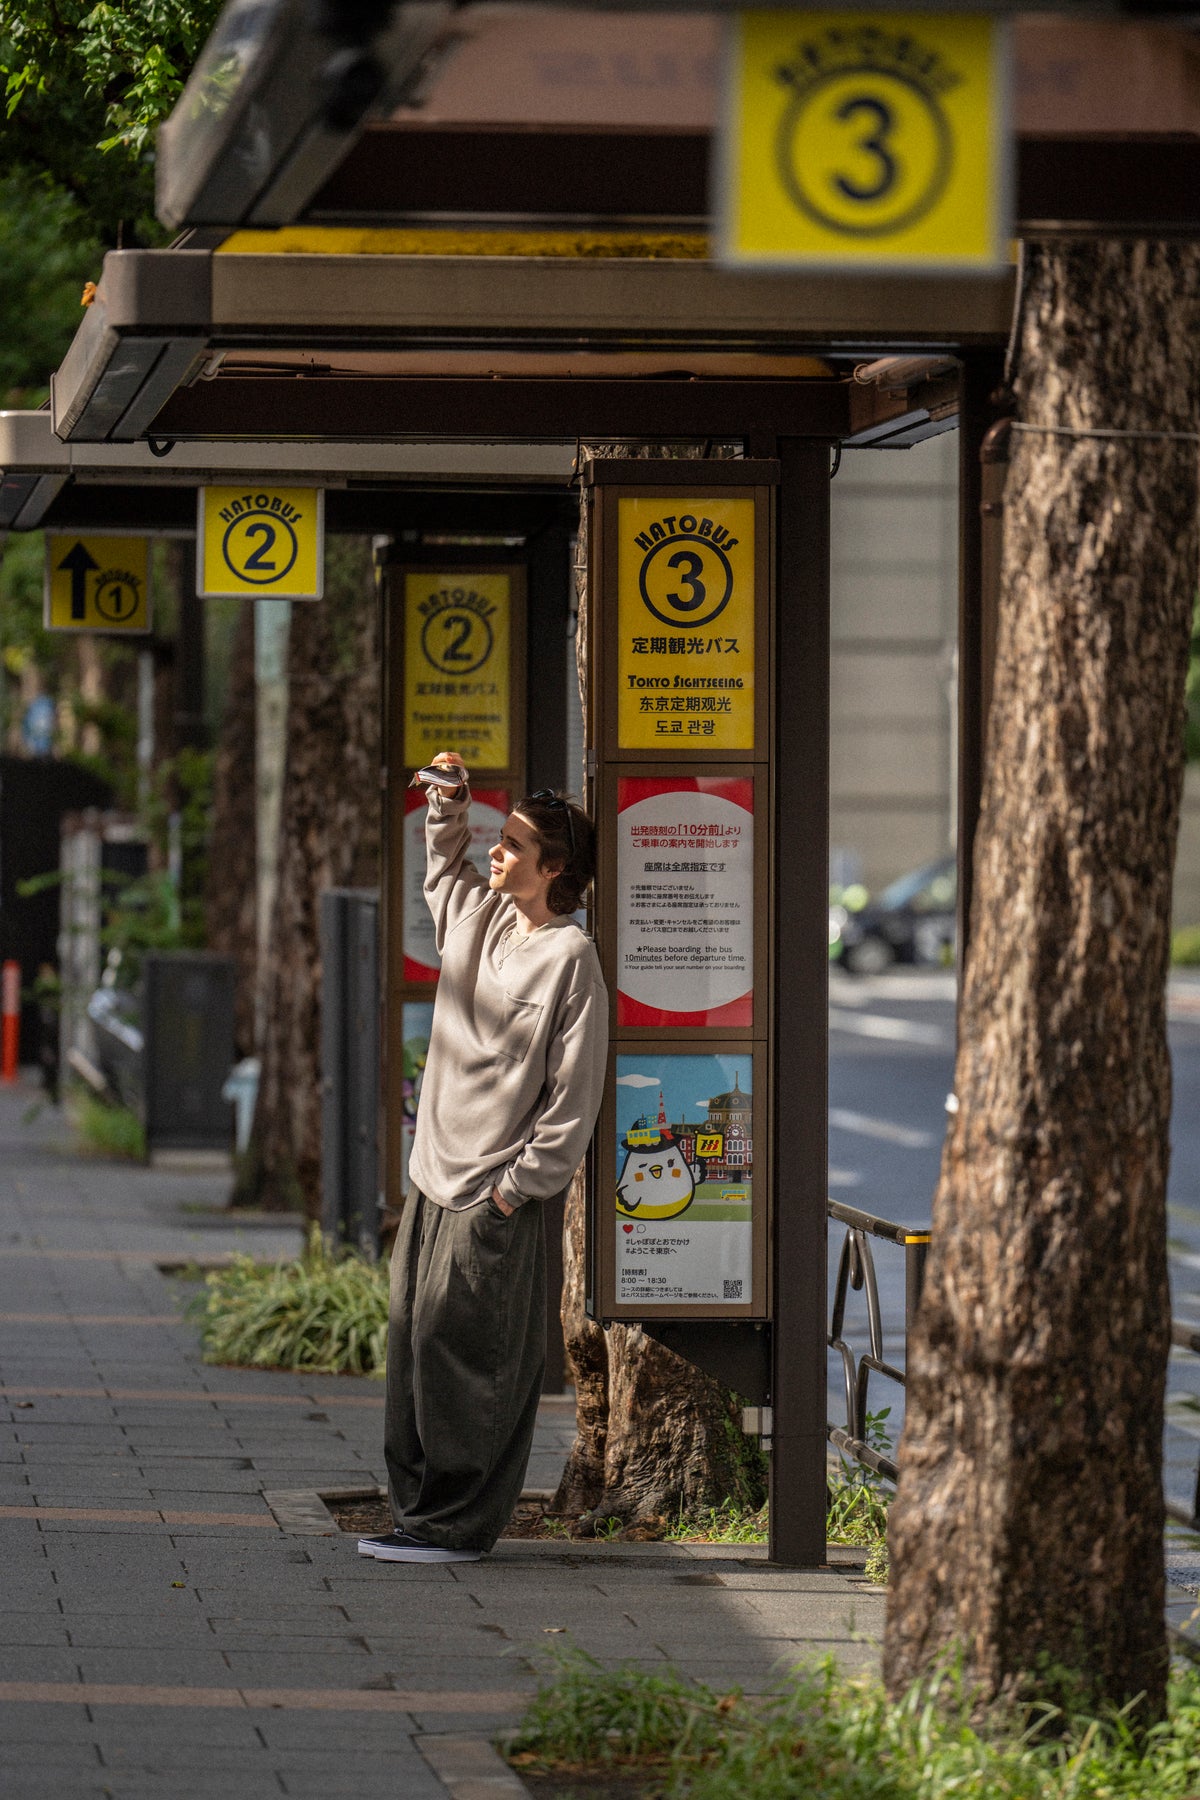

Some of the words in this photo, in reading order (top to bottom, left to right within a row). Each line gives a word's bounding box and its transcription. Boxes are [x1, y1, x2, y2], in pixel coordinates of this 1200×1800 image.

[832, 96, 898, 203] 3
[218, 494, 303, 524] HATOBUS
[634, 514, 740, 552] HATOBUS
[243, 522, 276, 571] 2
[666, 550, 707, 612] 3
[109, 585, 122, 614] 1
[443, 614, 474, 662] 2
[631, 637, 740, 655] 定期観光バス
[640, 696, 732, 712] 东京定期观光
[655, 720, 683, 734] 도쿄
[687, 720, 716, 735] 관광
[632, 838, 740, 849] ご乗車の案内を開始します
[644, 862, 726, 872] 座席は全席指定です
[668, 946, 701, 954] boarding
[690, 954, 726, 963] departure
